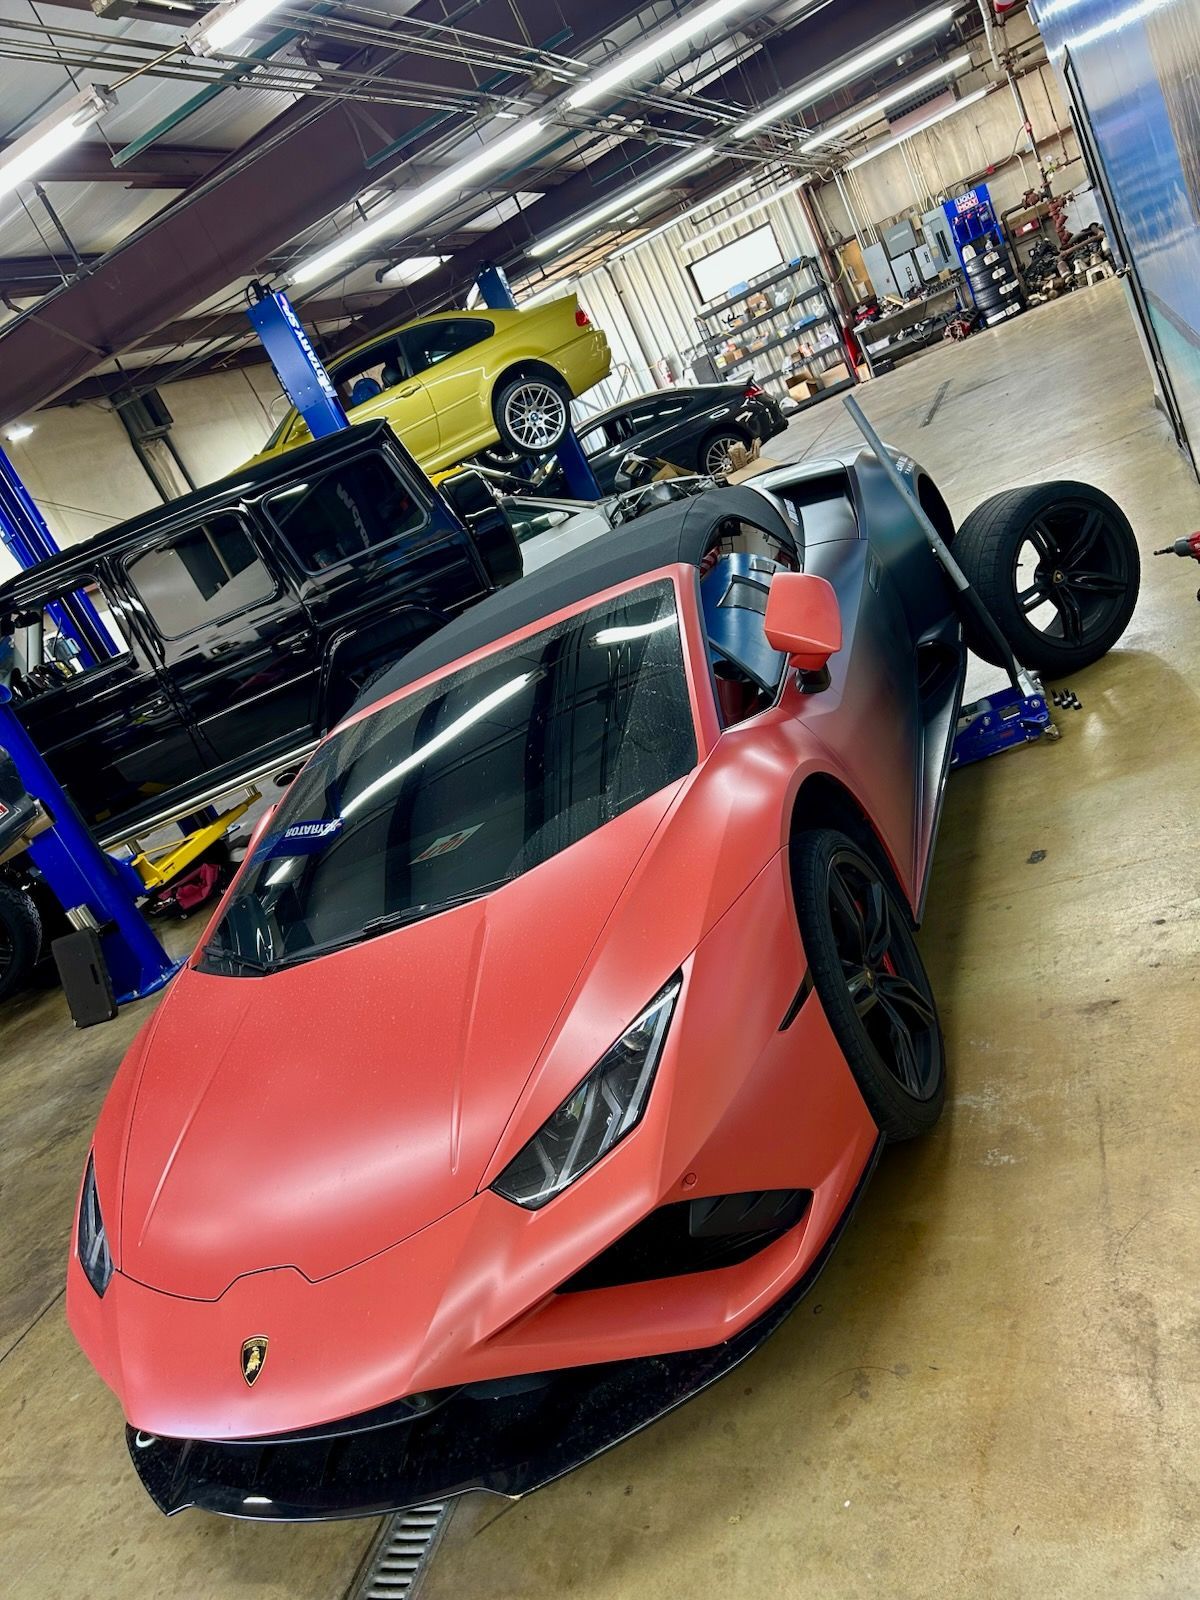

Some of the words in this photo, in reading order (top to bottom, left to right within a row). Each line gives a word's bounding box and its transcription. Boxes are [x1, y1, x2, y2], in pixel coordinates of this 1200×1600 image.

[955, 190, 977, 205] LIQUI
[957, 198, 979, 212] MOLY
[294, 328, 333, 393] ROTARY
